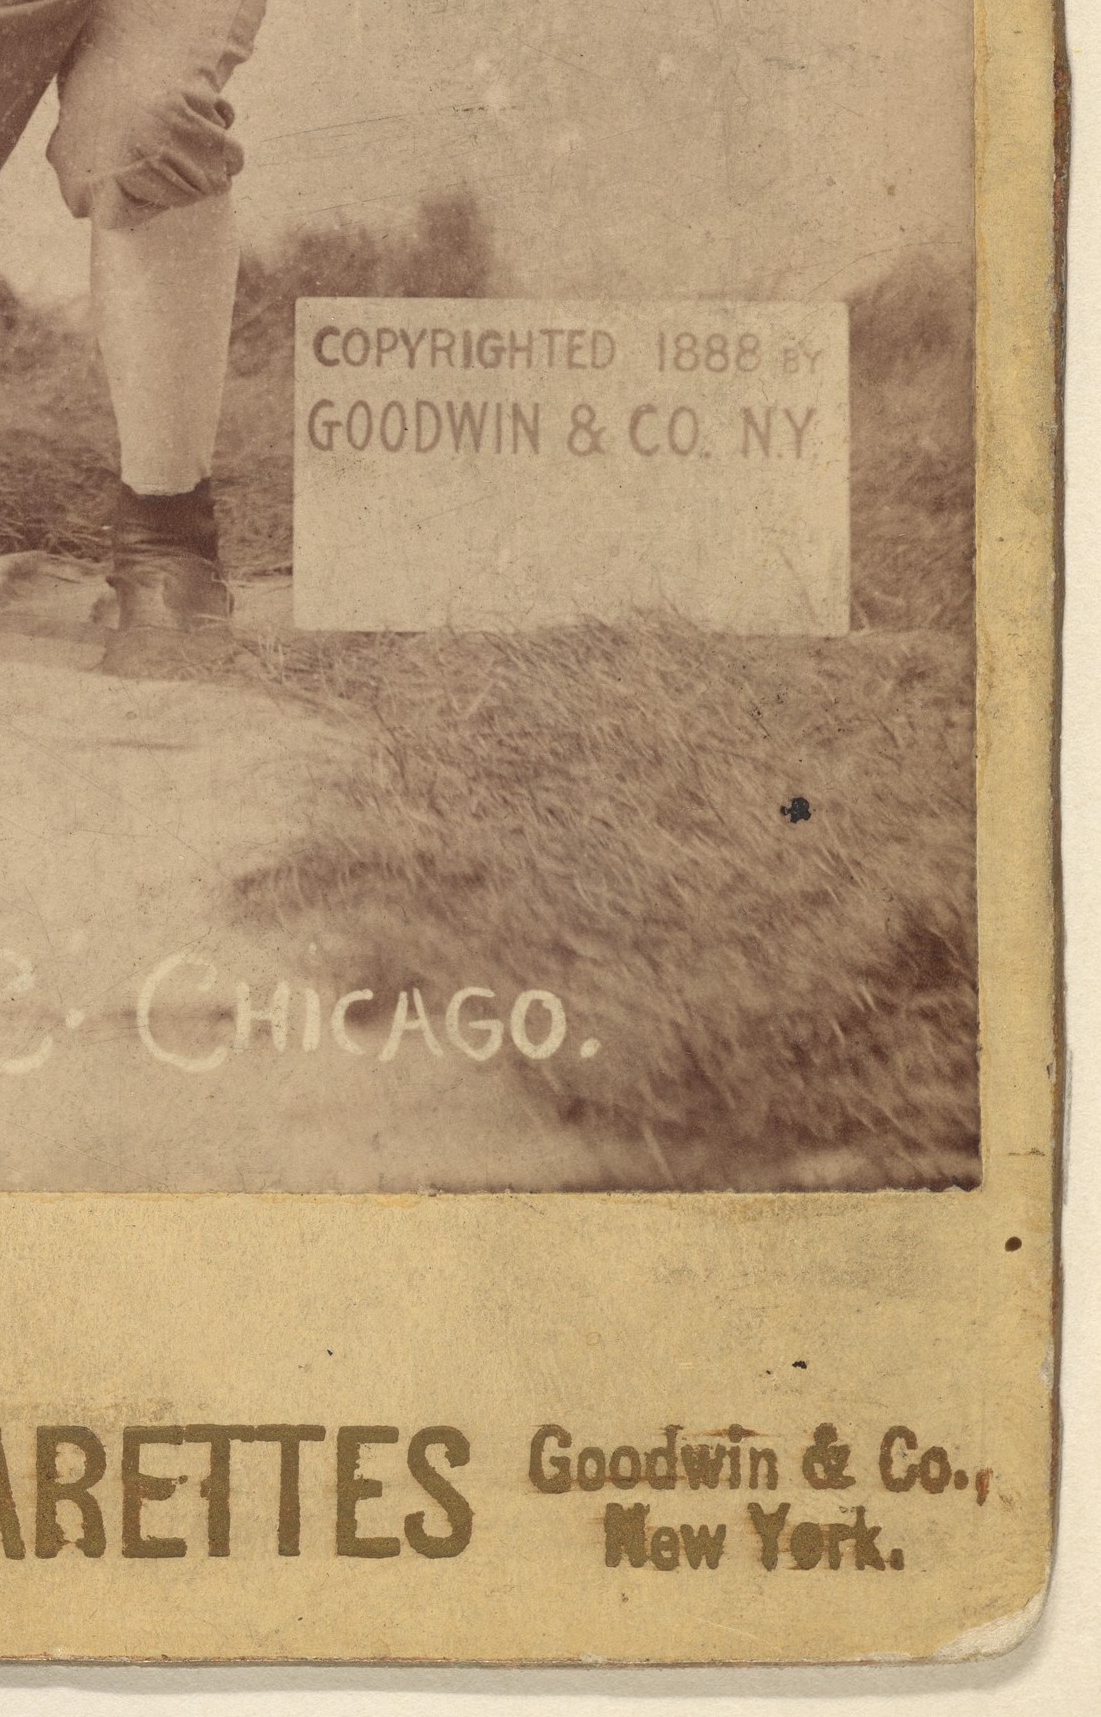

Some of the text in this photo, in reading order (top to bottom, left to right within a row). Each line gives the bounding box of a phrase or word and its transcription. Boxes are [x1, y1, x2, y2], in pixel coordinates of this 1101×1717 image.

[313, 325, 824, 375] COPYRIGHTED 1888 BY
[307, 398, 540, 454] GOODWIN
[566, 403, 606, 456] &
[628, 404, 712, 459] CO.
[529, 1424, 780, 1496] Goodwin
[801, 1424, 855, 1492] &
[604, 1502, 905, 1572] New York.
